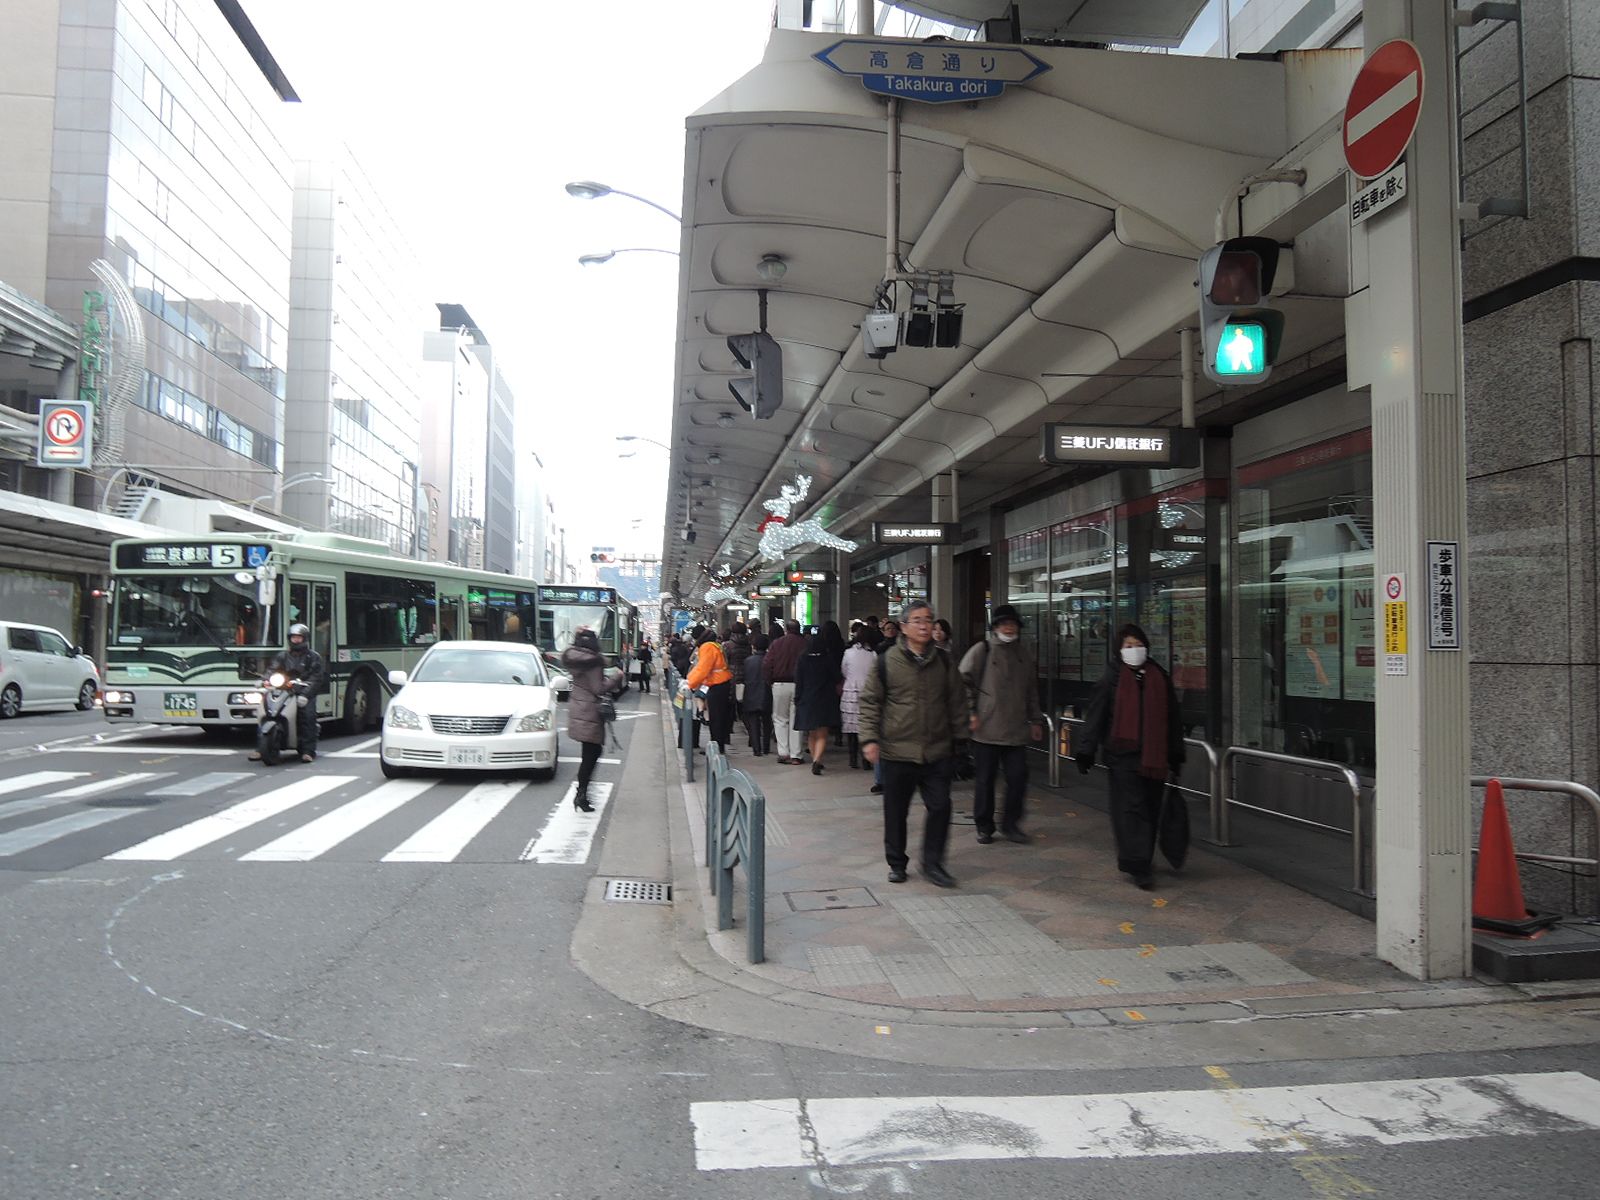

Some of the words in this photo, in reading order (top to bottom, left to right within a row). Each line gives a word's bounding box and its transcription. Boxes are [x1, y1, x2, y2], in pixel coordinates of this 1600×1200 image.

[869, 50, 995, 73] 高倉通り
[885, 75, 954, 93] Takakura
[960, 80, 988, 94] dori
[1060, 435, 1164, 451] 三菱UFJ信託銀行
[219, 548, 236, 565] 5
[580, 590, 596, 602] 46
[1438, 548, 1454, 637] 歩車分離信号
